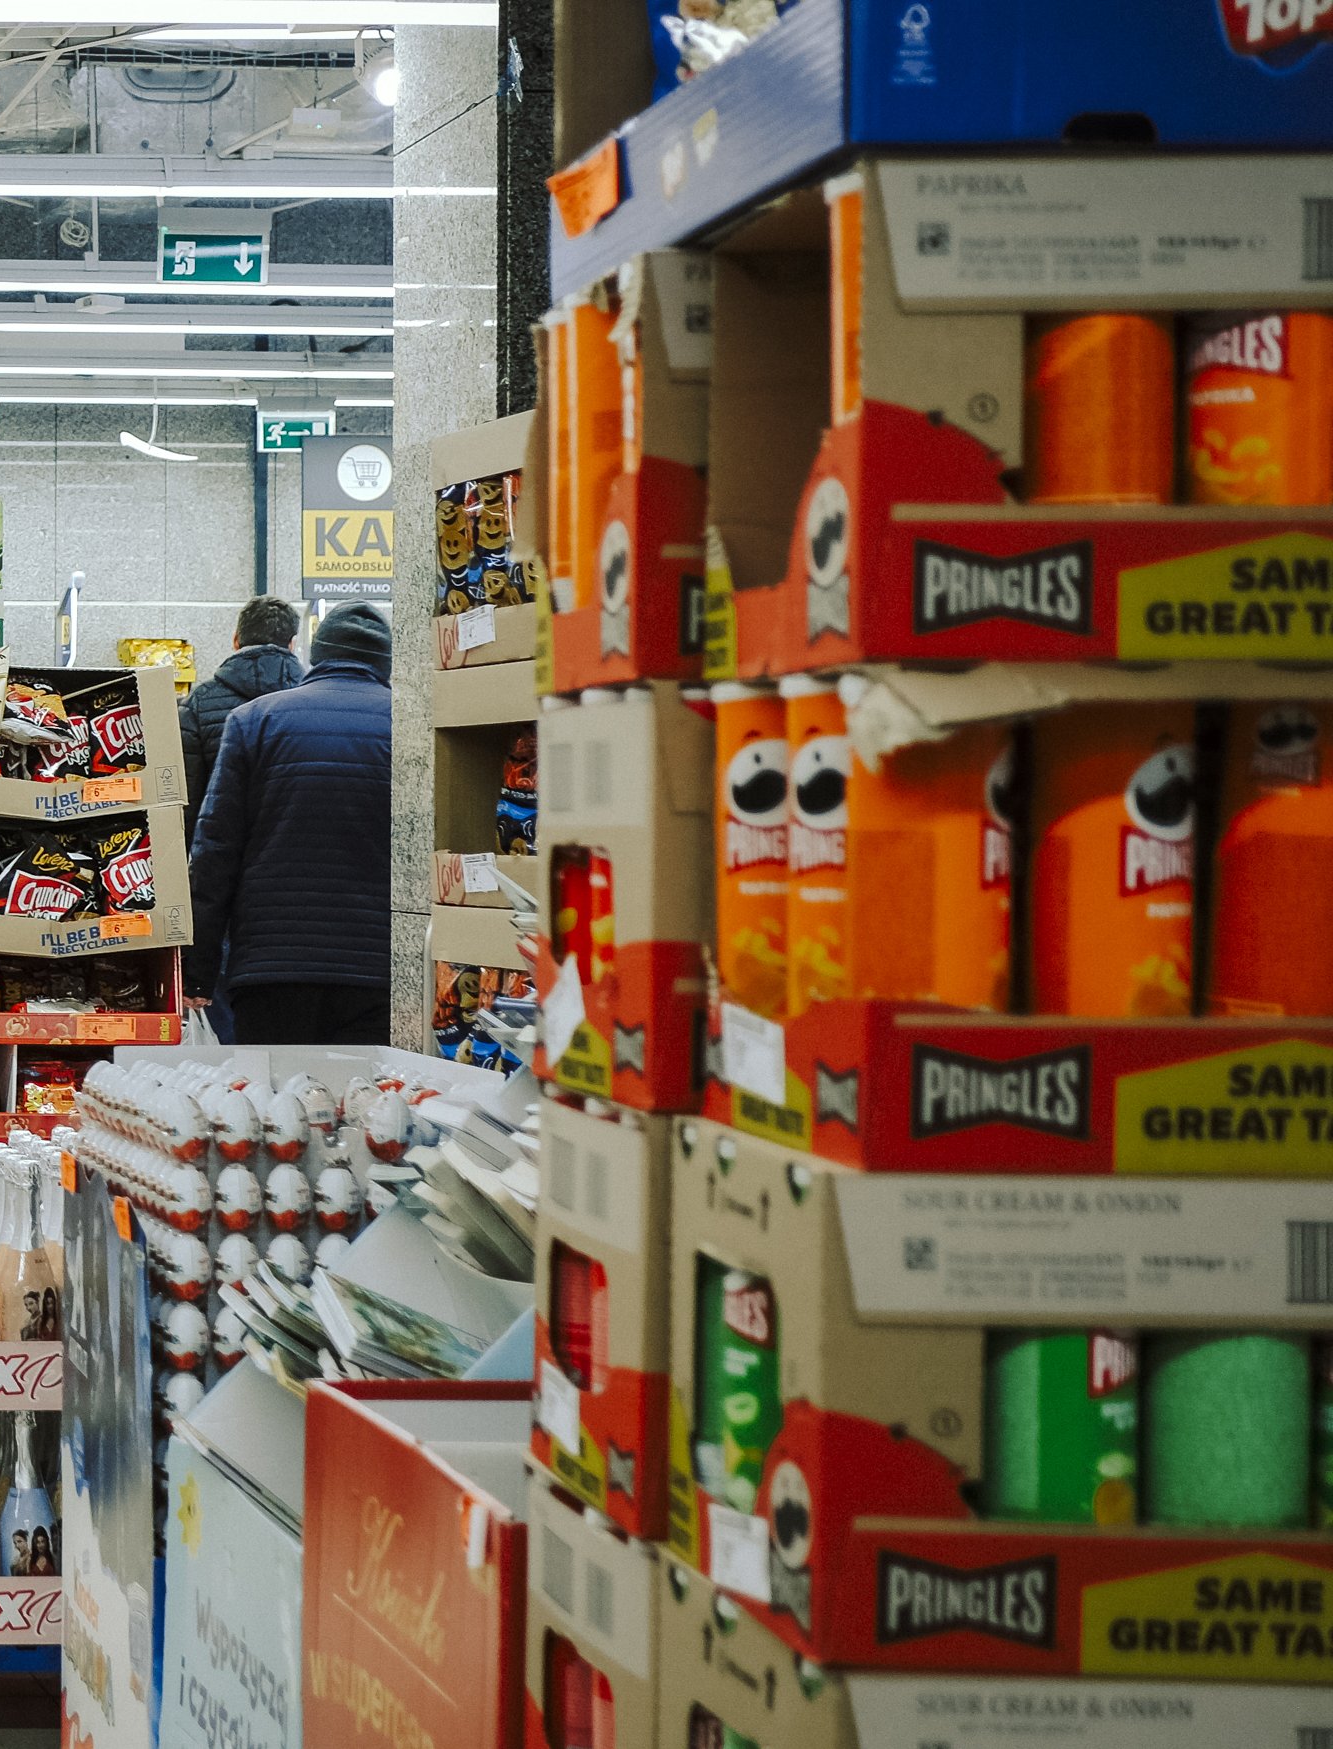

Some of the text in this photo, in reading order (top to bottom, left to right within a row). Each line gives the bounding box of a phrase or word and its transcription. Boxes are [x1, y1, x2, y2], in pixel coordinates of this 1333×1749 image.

[915, 174, 1028, 197] PAPRIKA
[315, 516, 391, 557] KA
[315, 560, 393, 573] SAMOOBSŁU
[314, 581, 391, 594] PŁATNOŚĆ TYLKO
[921, 550, 1083, 624] PRINGLES
[1145, 602, 1292, 637] GREAT
[45, 800, 122, 819] #RECYCLABLE
[60, 791, 79, 808] BE
[98, 827, 143, 858] Lorenz
[32, 846, 76, 872] Lorenz
[41, 932, 65, 947] I'LL
[66, 929, 87, 943] BE
[51, 936, 129, 955] #RECYCLABLE
[920, 1056, 1082, 1127] PRINGLES
[1142, 1108, 1292, 1142] GREAT
[904, 1192, 972, 1215] SOUR
[978, 1192, 1066, 1215] CREAM
[1094, 1193, 1182, 1215] ONION
[884, 1569, 1048, 1638] PRINGLES
[1194, 1578, 1325, 1613] SAME
[1108, 1619, 1261, 1659] GREAT
[914, 1694, 988, 1719] SOUR
[994, 1694, 1079, 1719] CREAM
[1106, 1695, 1193, 1719] ONION
